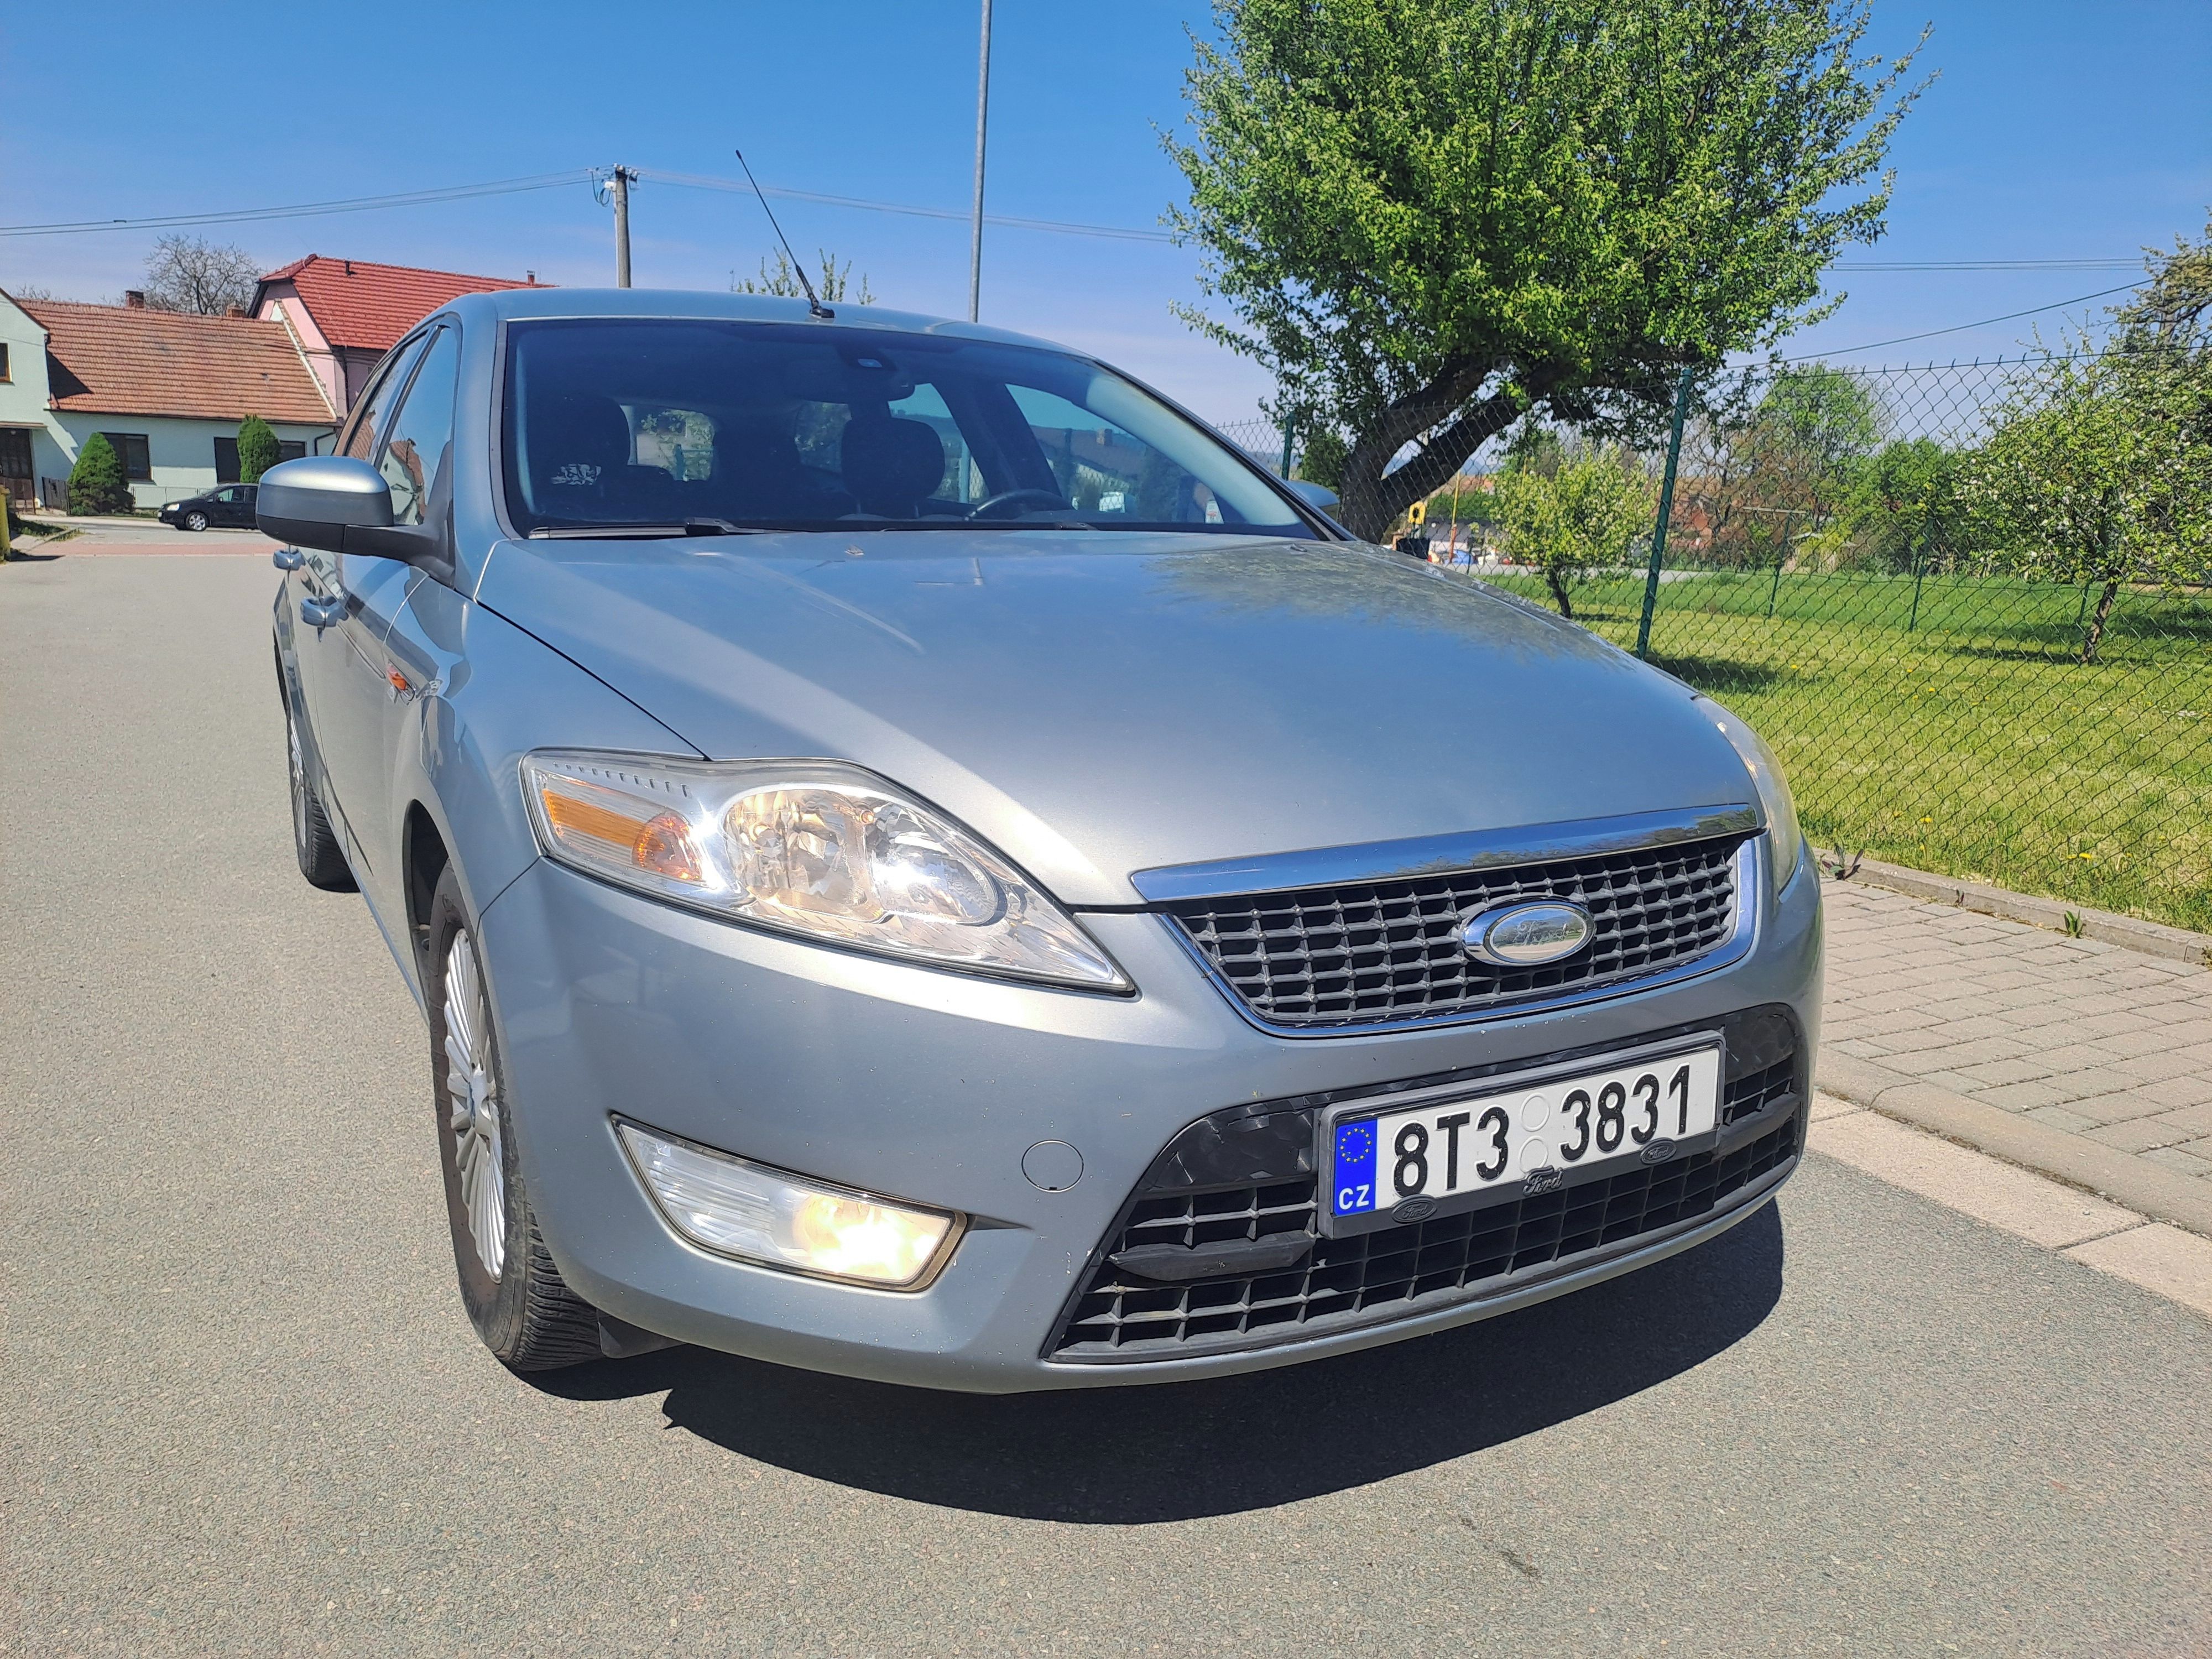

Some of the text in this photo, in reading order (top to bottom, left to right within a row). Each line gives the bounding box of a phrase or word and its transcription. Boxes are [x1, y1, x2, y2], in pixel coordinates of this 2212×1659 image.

[1394, 1064, 1690, 1198] 8T3 3831
[1522, 1165, 1563, 1197] Ford
[1339, 1184, 1370, 1210] CZ
[1402, 1203, 1428, 1219] Ford
